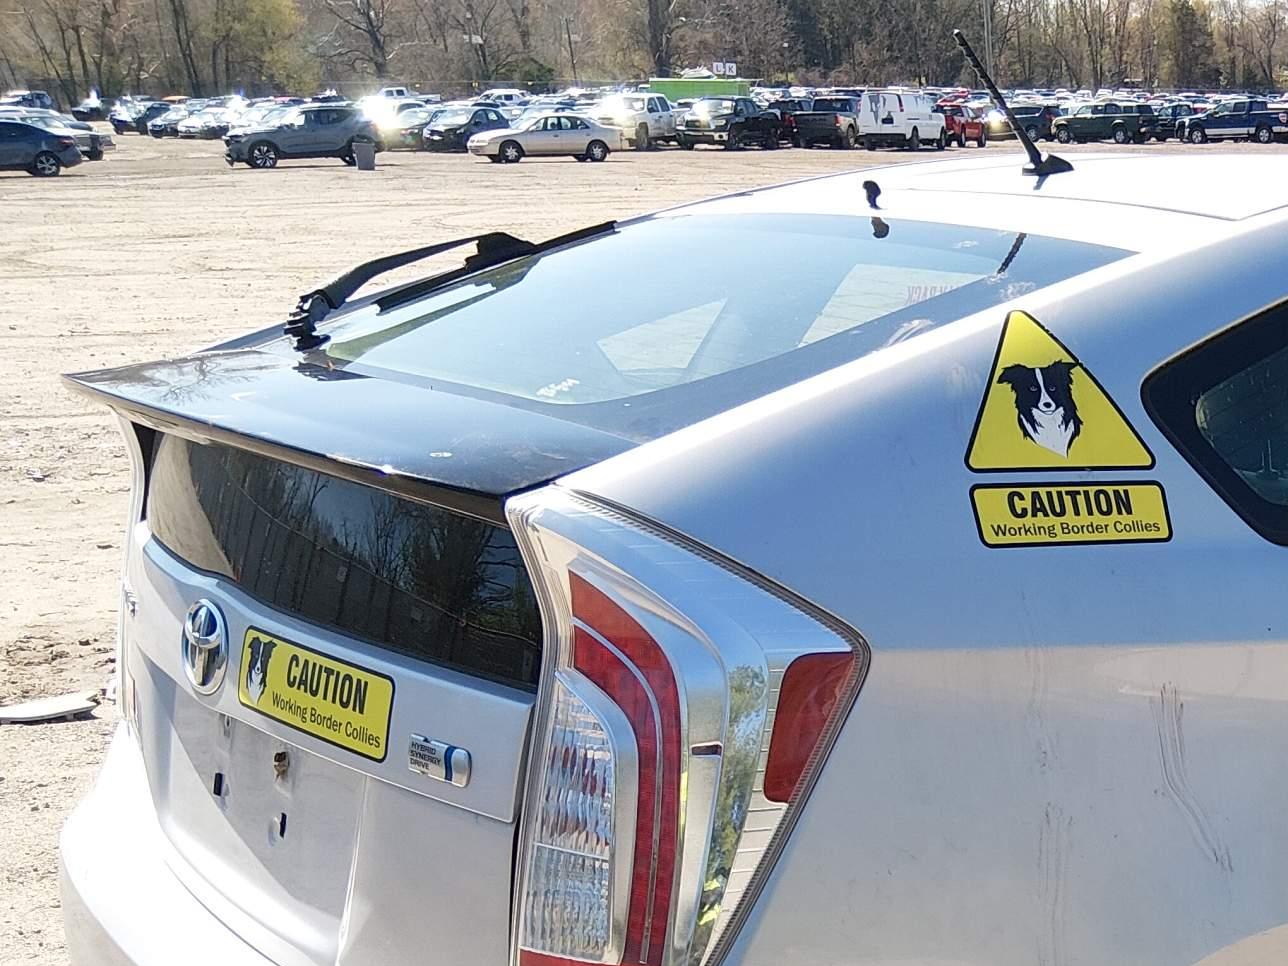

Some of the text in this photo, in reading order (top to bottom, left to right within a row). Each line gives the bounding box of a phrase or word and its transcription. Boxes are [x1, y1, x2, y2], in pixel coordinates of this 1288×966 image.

[1007, 489, 1133, 519] CAUTION
[991, 520, 1161, 538] Working Border Collies
[286, 653, 369, 715] CAUTION
[272, 690, 381, 749] Working Border Collies
[409, 749, 441, 766] SYNERGY
[411, 741, 437, 756] HYBRID
[409, 757, 430, 770] DRIVE
